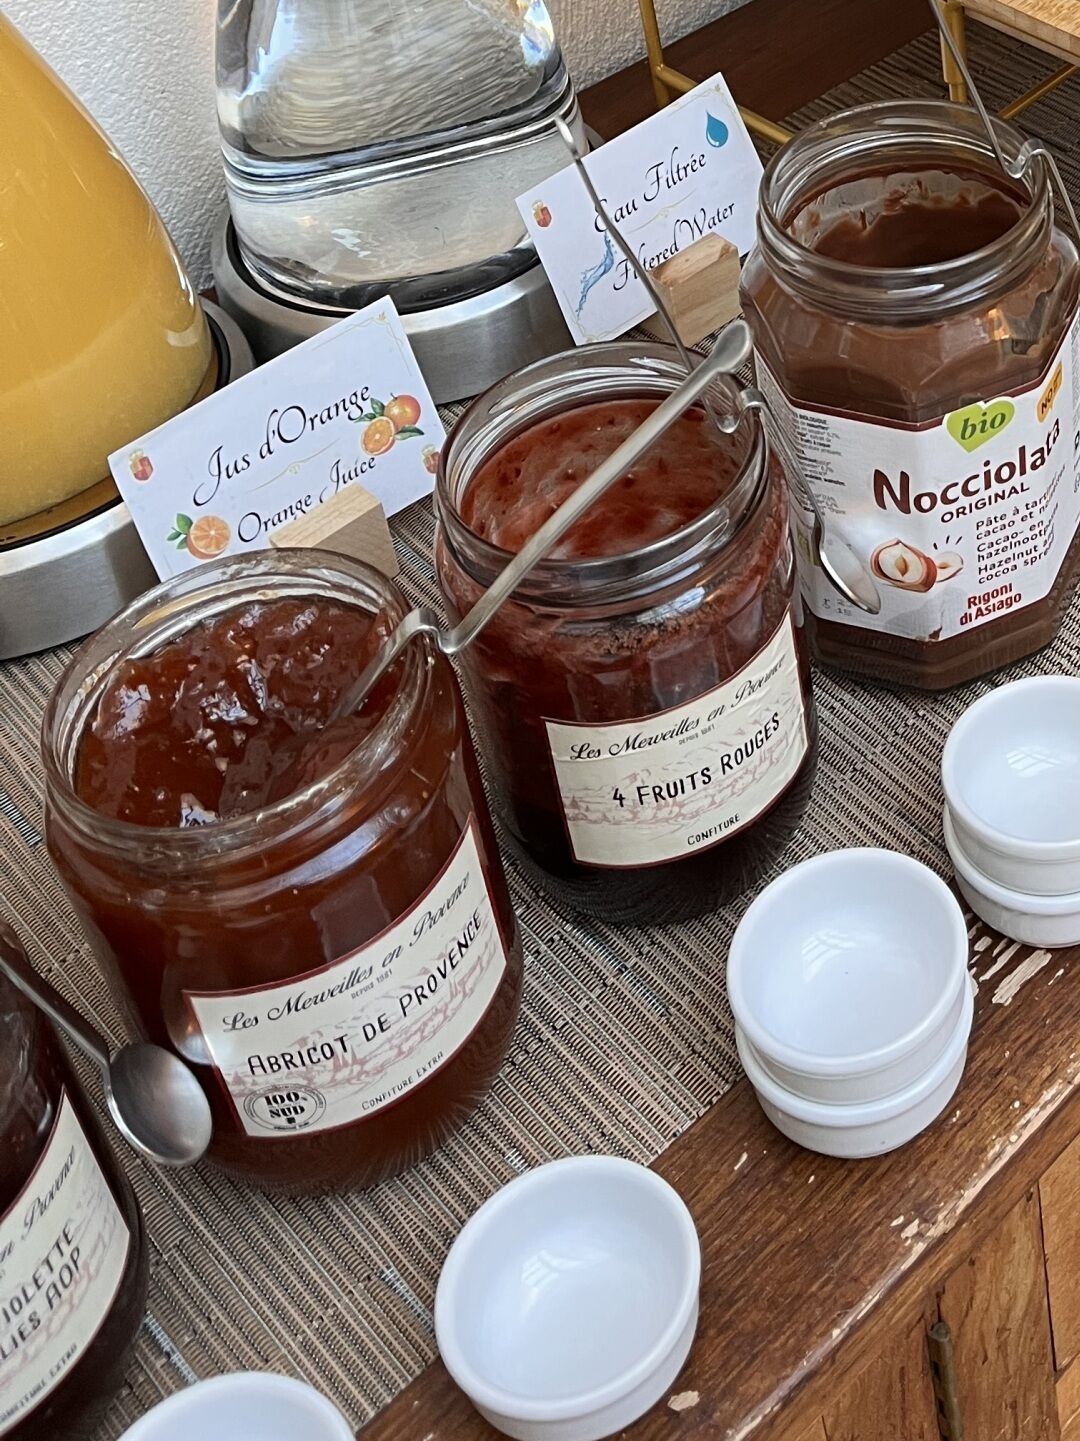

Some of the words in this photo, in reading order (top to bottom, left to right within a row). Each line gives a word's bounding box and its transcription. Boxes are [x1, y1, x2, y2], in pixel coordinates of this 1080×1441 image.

[594, 196, 639, 233] Eau
[643, 146, 707, 202] Filtrée
[679, 201, 735, 241] Water
[193, 445, 251, 507] Jus
[259, 385, 371, 460] d'Orange
[960, 410, 1007, 441] bio
[873, 418, 1060, 515] Nocciolata
[237, 493, 312, 543] Orange
[319, 456, 377, 503] Juice
[940, 482, 1030, 524] ORIGINAL
[976, 513, 1007, 531] Pâte
[1012, 506, 1020, 516] à
[976, 520, 1015, 540] cacao
[1020, 511, 1034, 522] et
[1029, 520, 1044, 532] en
[978, 545, 1039, 575] Hazelnut
[978, 564, 1018, 584] cocoa
[959, 609, 975, 626] di
[974, 592, 1023, 621] Asiago
[967, 583, 1013, 609] Rigoni
[569, 742, 601, 760] Les
[609, 717, 700, 756] Merveilles
[707, 704, 726, 722] en
[612, 788, 626, 807] 4
[636, 767, 713, 805] FRUITS
[719, 711, 781, 775] ROUGES
[687, 813, 740, 846] CONFITURE
[222, 1011, 260, 1033] Les
[267, 966, 374, 1021] Merveilles
[381, 944, 405, 969] en
[247, 1034, 349, 1076] ABRICOT
[362, 1013, 392, 1042] DE
[398, 907, 482, 1017] PROVENCE
[361, 1075, 414, 1111] CONFITURE
[416, 1050, 444, 1077] EXTRA
[2, 1220, 74, 1324] IOLETTE
[46, 1246, 80, 1311] AOP
